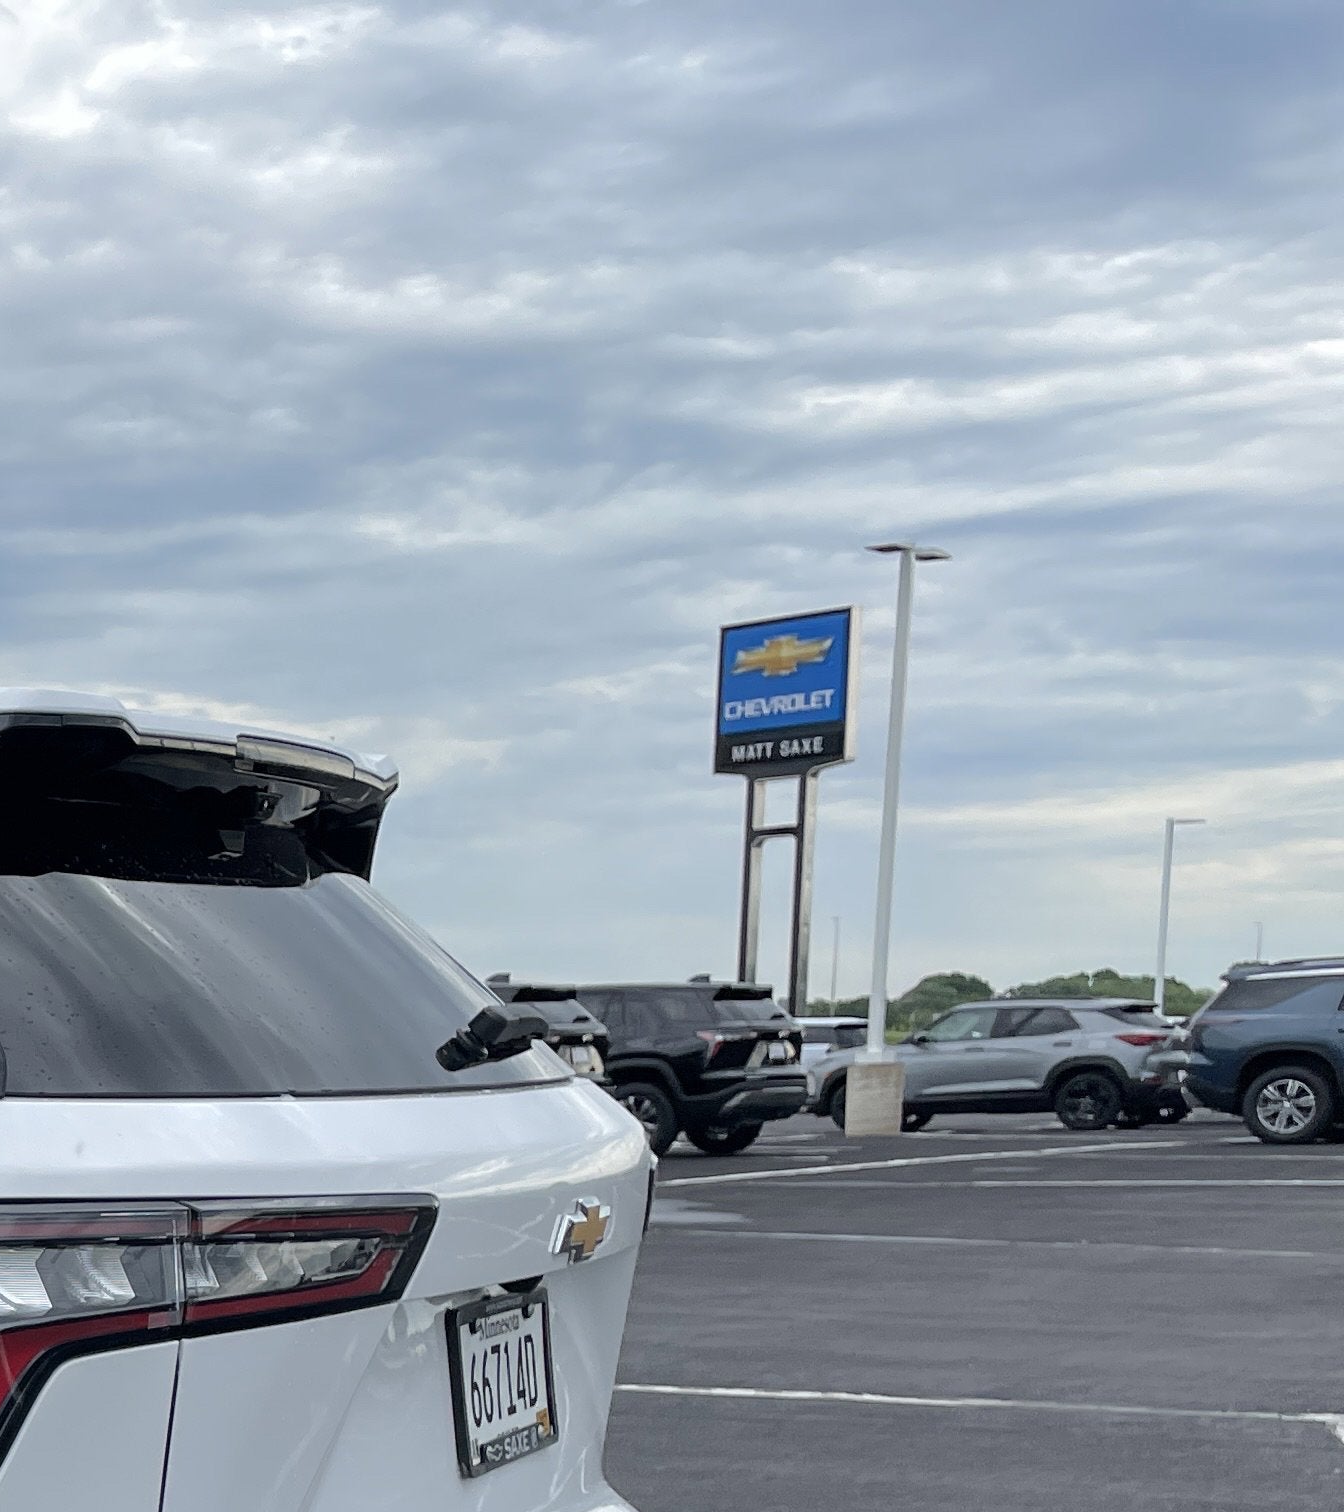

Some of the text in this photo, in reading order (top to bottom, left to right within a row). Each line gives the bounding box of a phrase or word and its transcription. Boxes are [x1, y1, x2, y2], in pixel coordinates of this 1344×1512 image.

[724, 688, 835, 720] CHEVROLET
[731, 735, 824, 762] MATT SAXE
[470, 1334, 538, 1428] 66714D
[503, 1429, 530, 1460] SAXE
